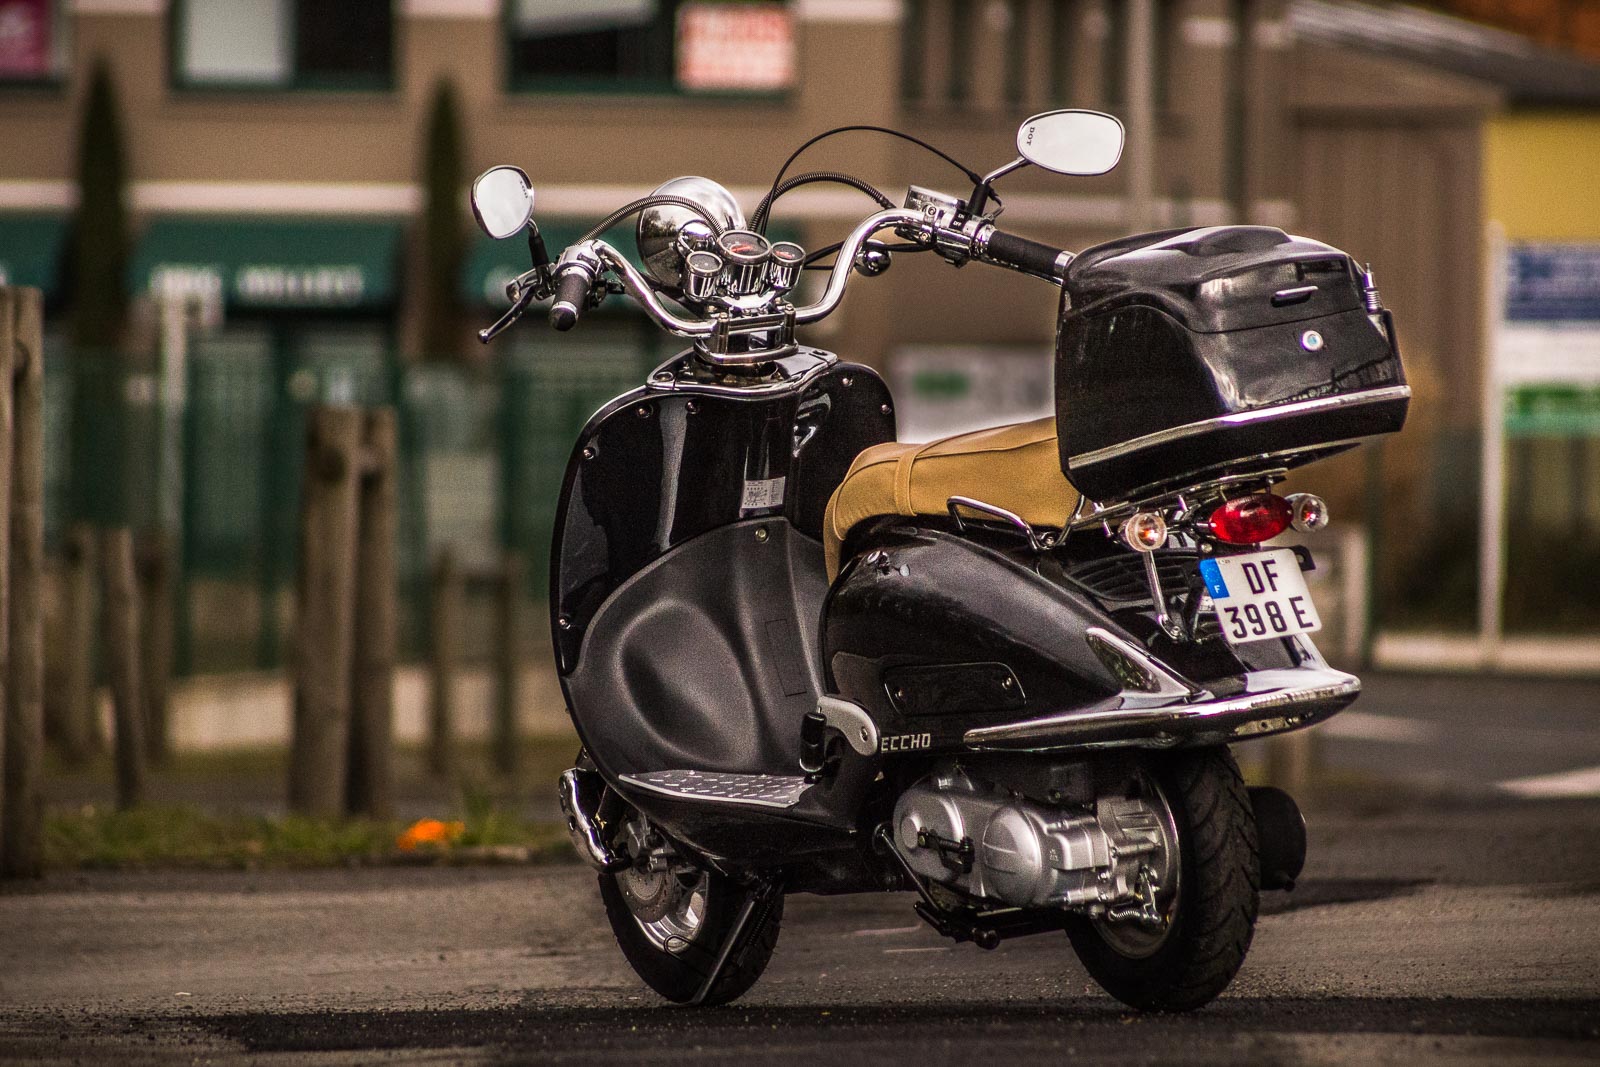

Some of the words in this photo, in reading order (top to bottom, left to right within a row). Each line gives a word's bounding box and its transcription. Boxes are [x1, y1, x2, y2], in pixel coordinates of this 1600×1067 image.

[1026, 126, 1036, 146] DOT
[1241, 558, 1279, 595] DF
[1213, 584, 1221, 594] F
[1223, 600, 1288, 639] 398
[1288, 595, 1314, 629] E
[880, 732, 931, 752] ECCHO
